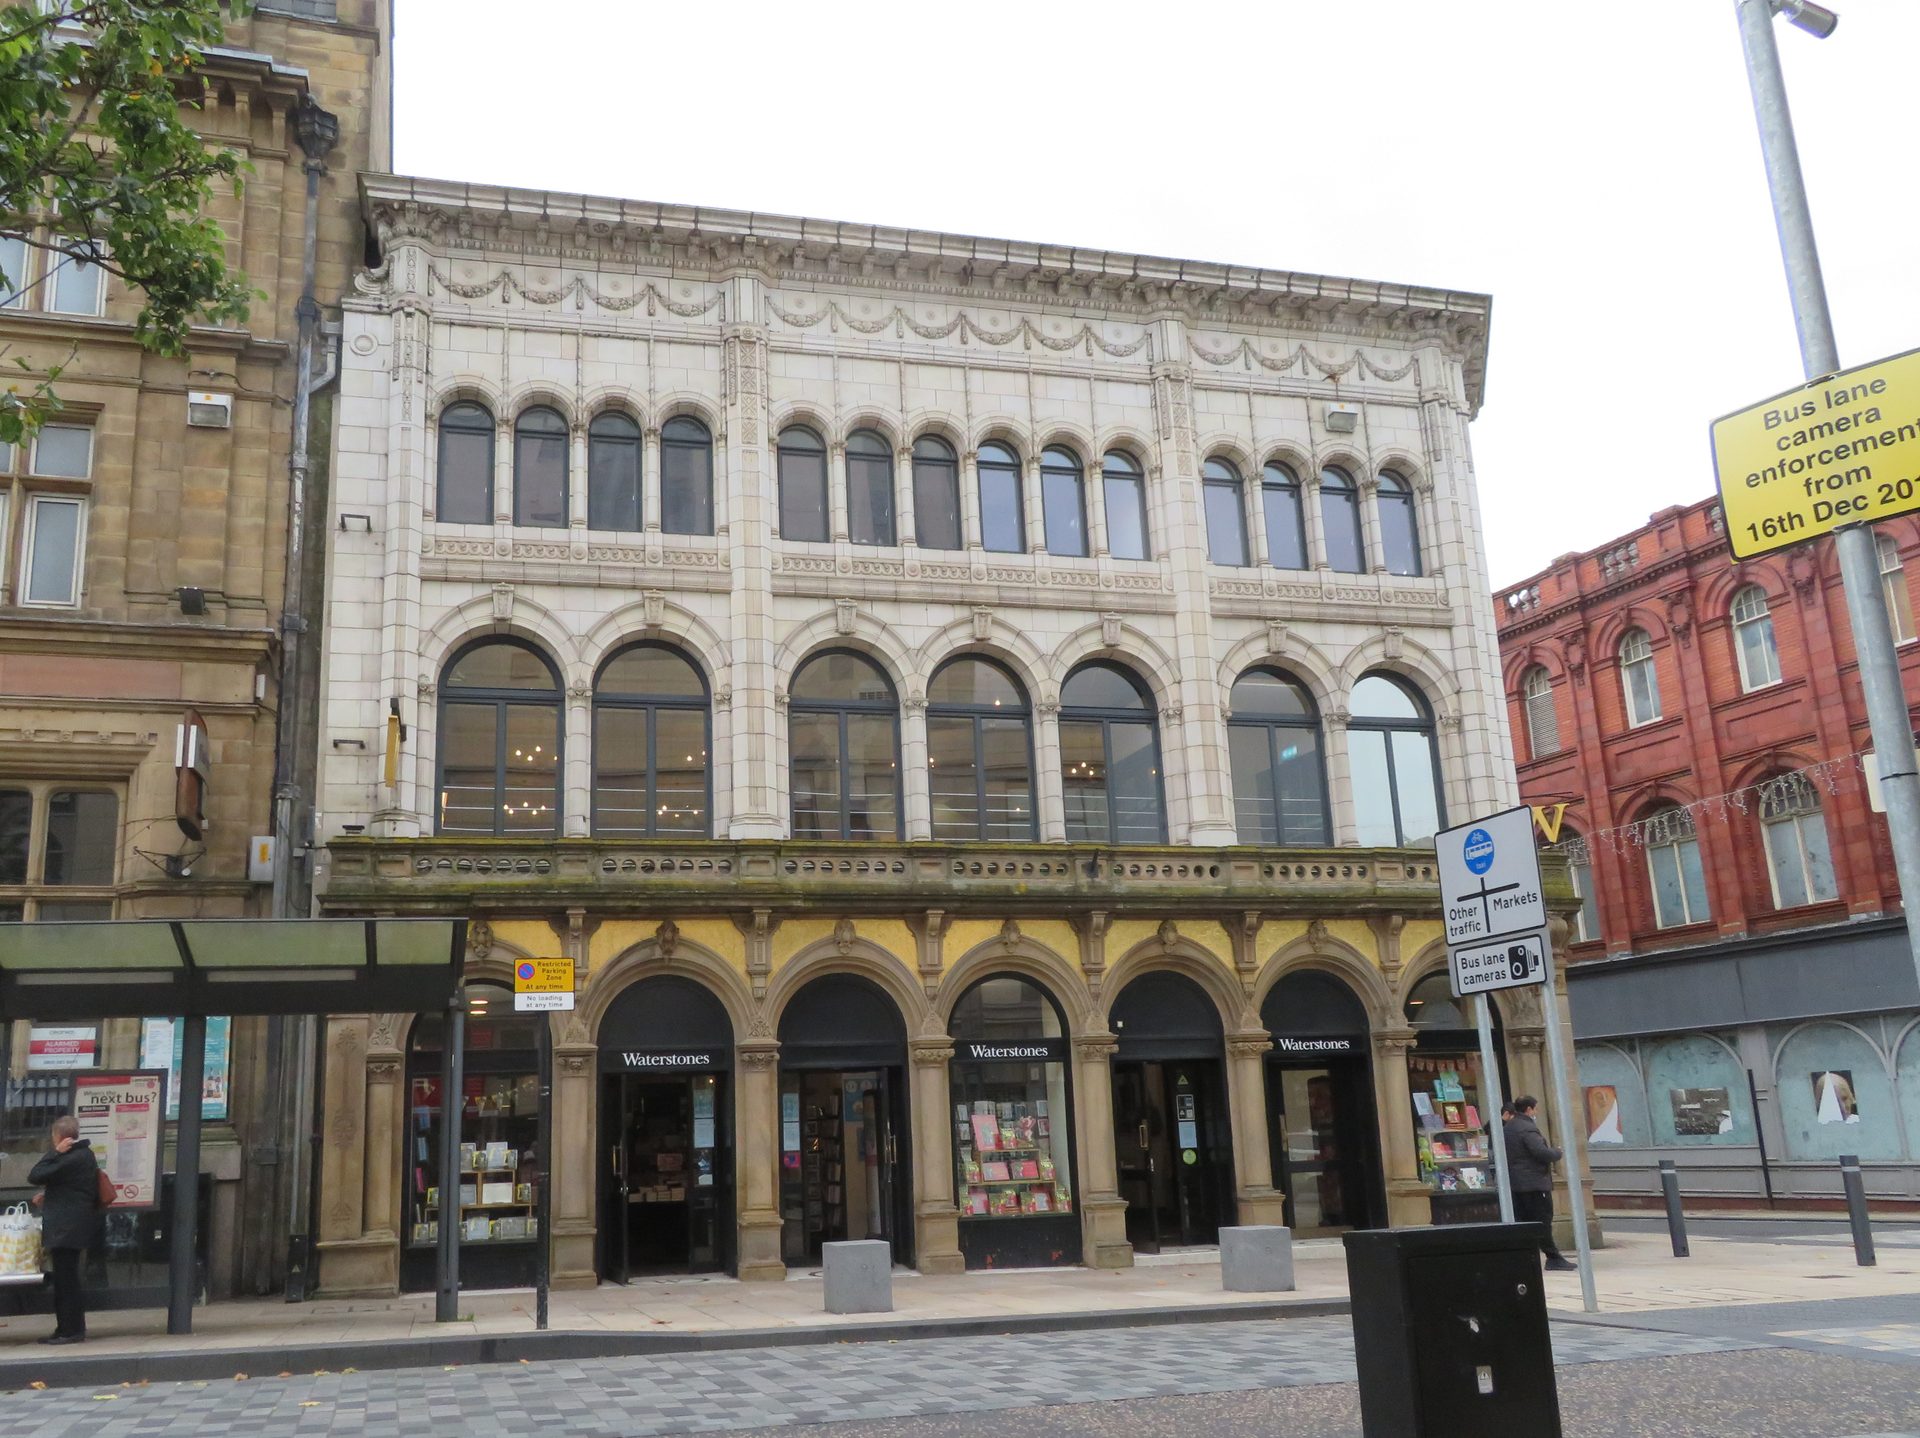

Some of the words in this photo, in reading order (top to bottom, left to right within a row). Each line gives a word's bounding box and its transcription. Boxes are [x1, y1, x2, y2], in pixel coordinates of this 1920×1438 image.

[1763, 401, 1816, 430] Bus
[1824, 378, 1887, 409] lane
[1776, 407, 1882, 451] camera
[1803, 465, 1872, 497] from
[1747, 511, 1805, 541] 16th
[1812, 494, 1869, 523] Dec
[1877, 476, 1920, 505] 20
[1493, 891, 1538, 911] Markets
[1450, 906, 1478, 921] Other
[1450, 921, 1482, 937] traffic
[1461, 957, 1480, 970] Bus
[1483, 952, 1505, 966] lane
[1463, 969, 1507, 985] cameras
[970, 1044, 1049, 1058] Waterstones
[1279, 1038, 1350, 1051] Waterstones
[622, 1052, 710, 1066] Waterstones
[91, 1094, 122, 1104] next
[125, 1091, 157, 1104] bus?
